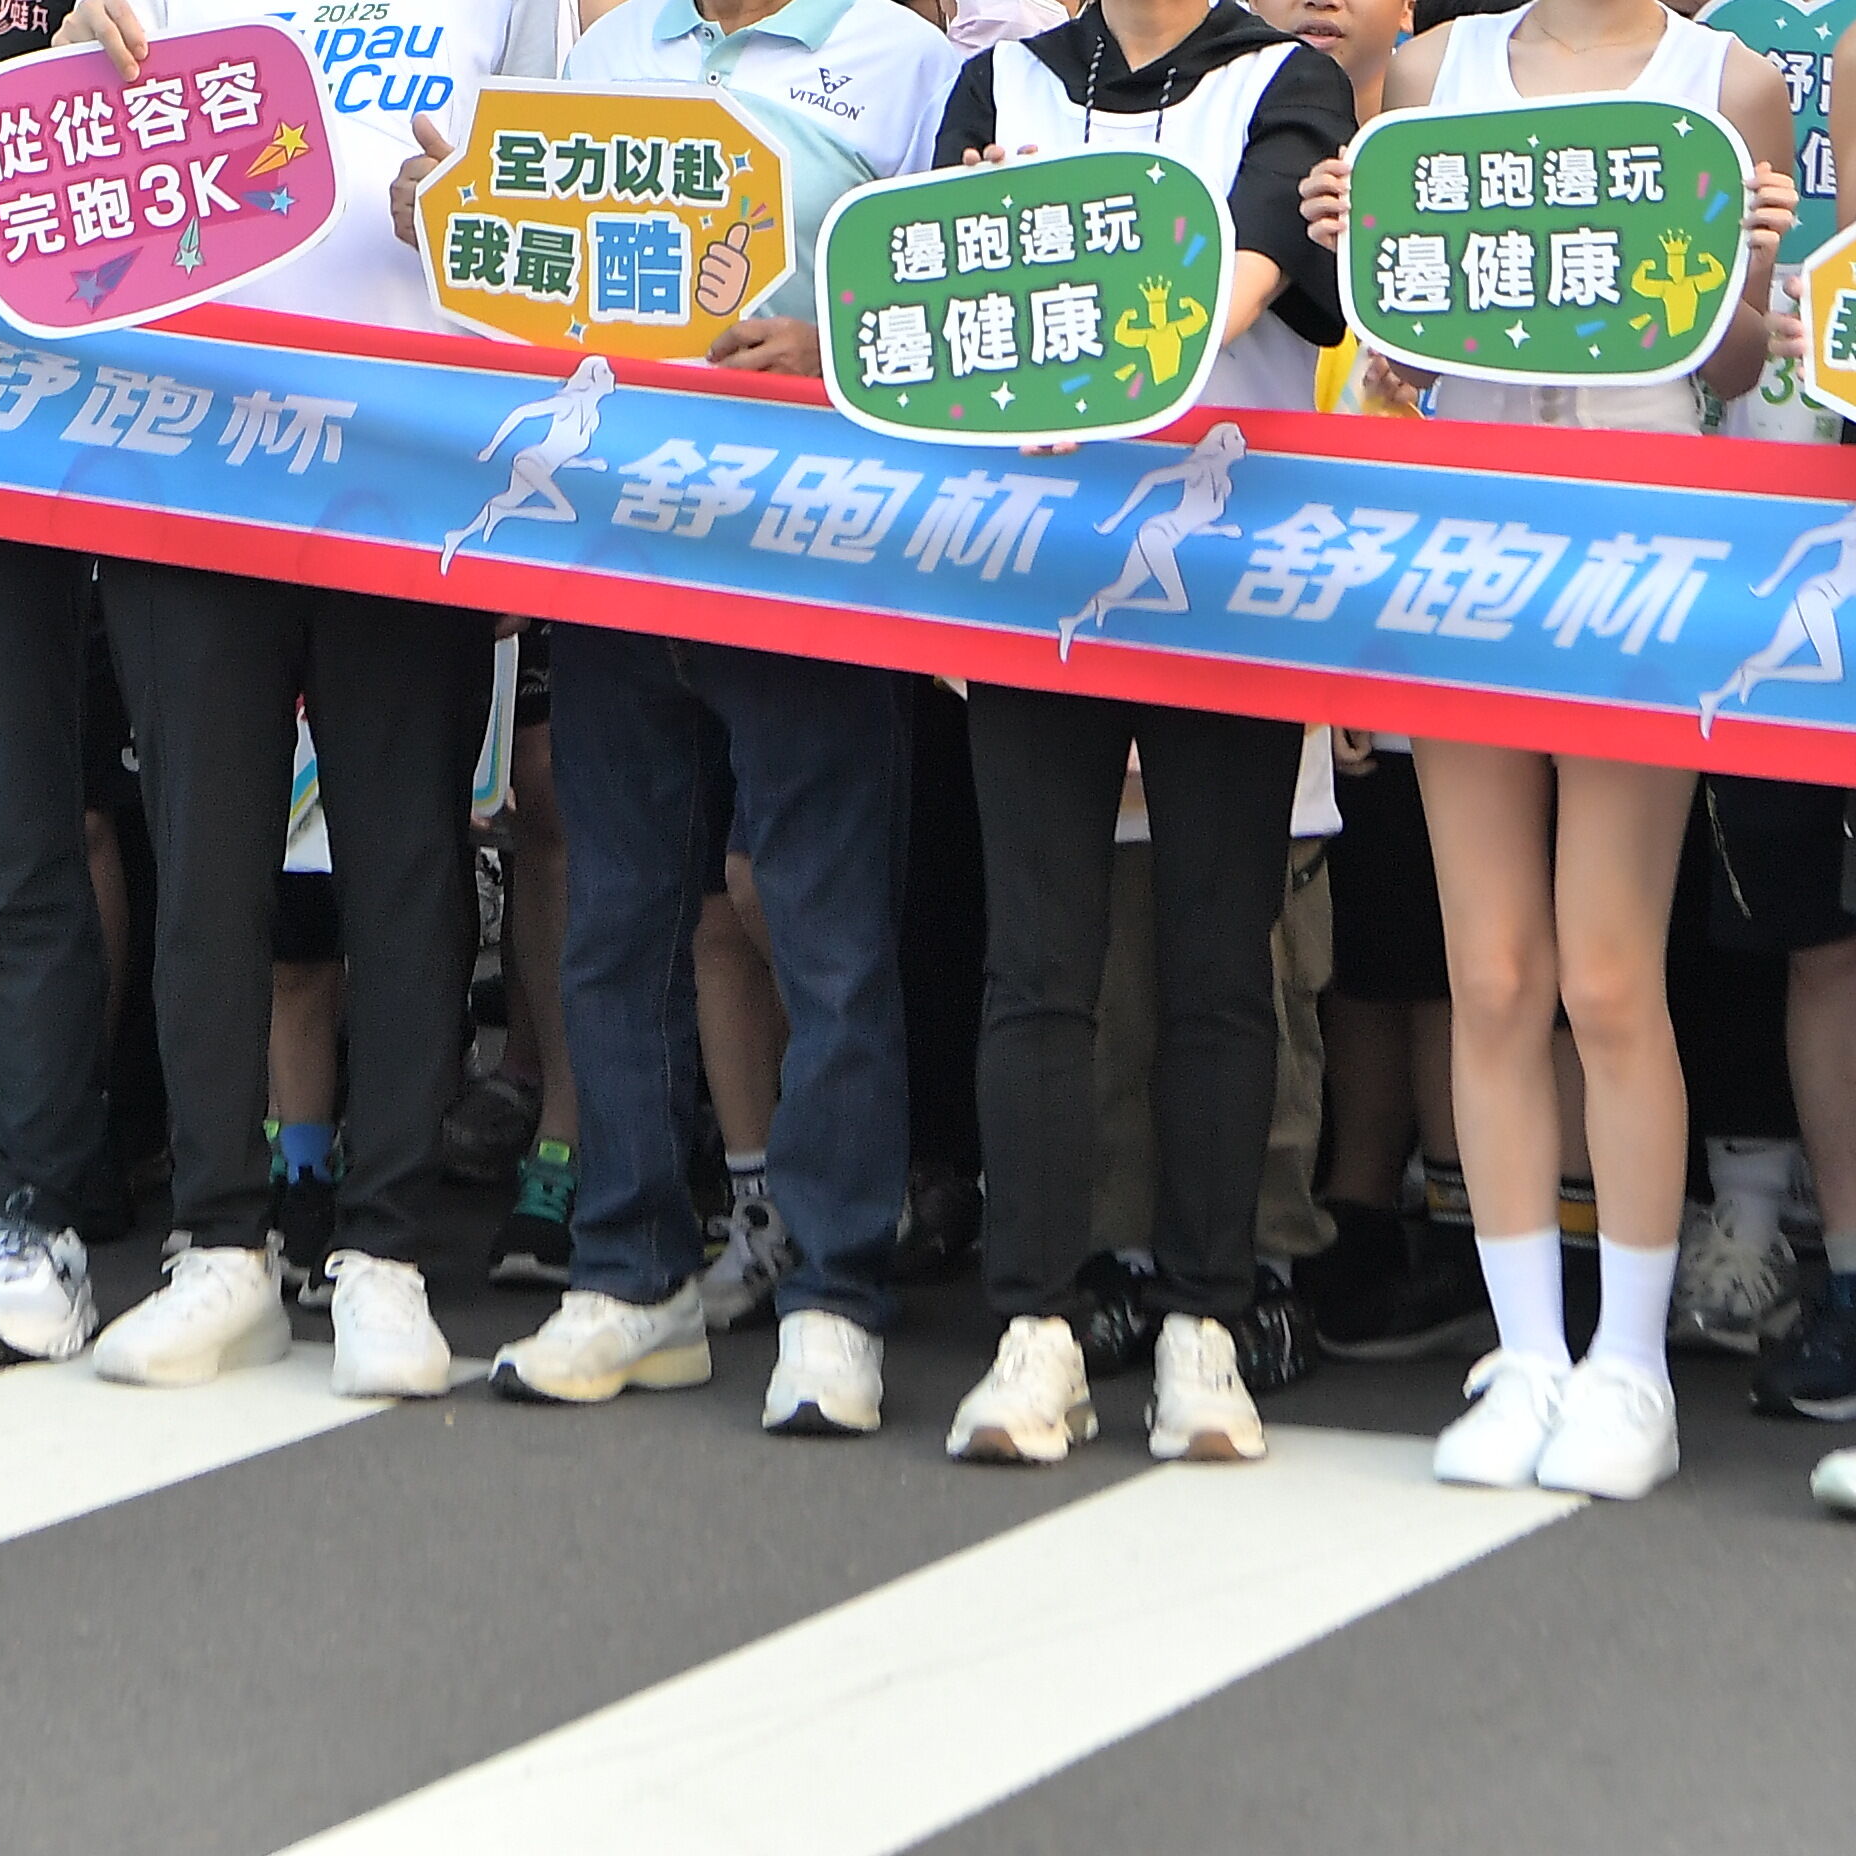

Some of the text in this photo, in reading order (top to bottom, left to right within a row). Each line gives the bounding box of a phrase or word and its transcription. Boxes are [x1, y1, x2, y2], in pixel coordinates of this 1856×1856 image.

[334, 64, 454, 124] Cup
[789, 87, 861, 121] VITALON
[493, 133, 728, 200] 全力以赴
[1414, 145, 1666, 215] 邊跑邊玩
[447, 217, 688, 317] 我最酷
[891, 194, 1143, 285] 邊跑邊玩
[1376, 228, 1622, 315] 邊健康
[857, 283, 1106, 389] 邊健康
[610, 437, 1080, 582] 舒跑杯
[1226, 501, 1733, 656] 舒跑杯
